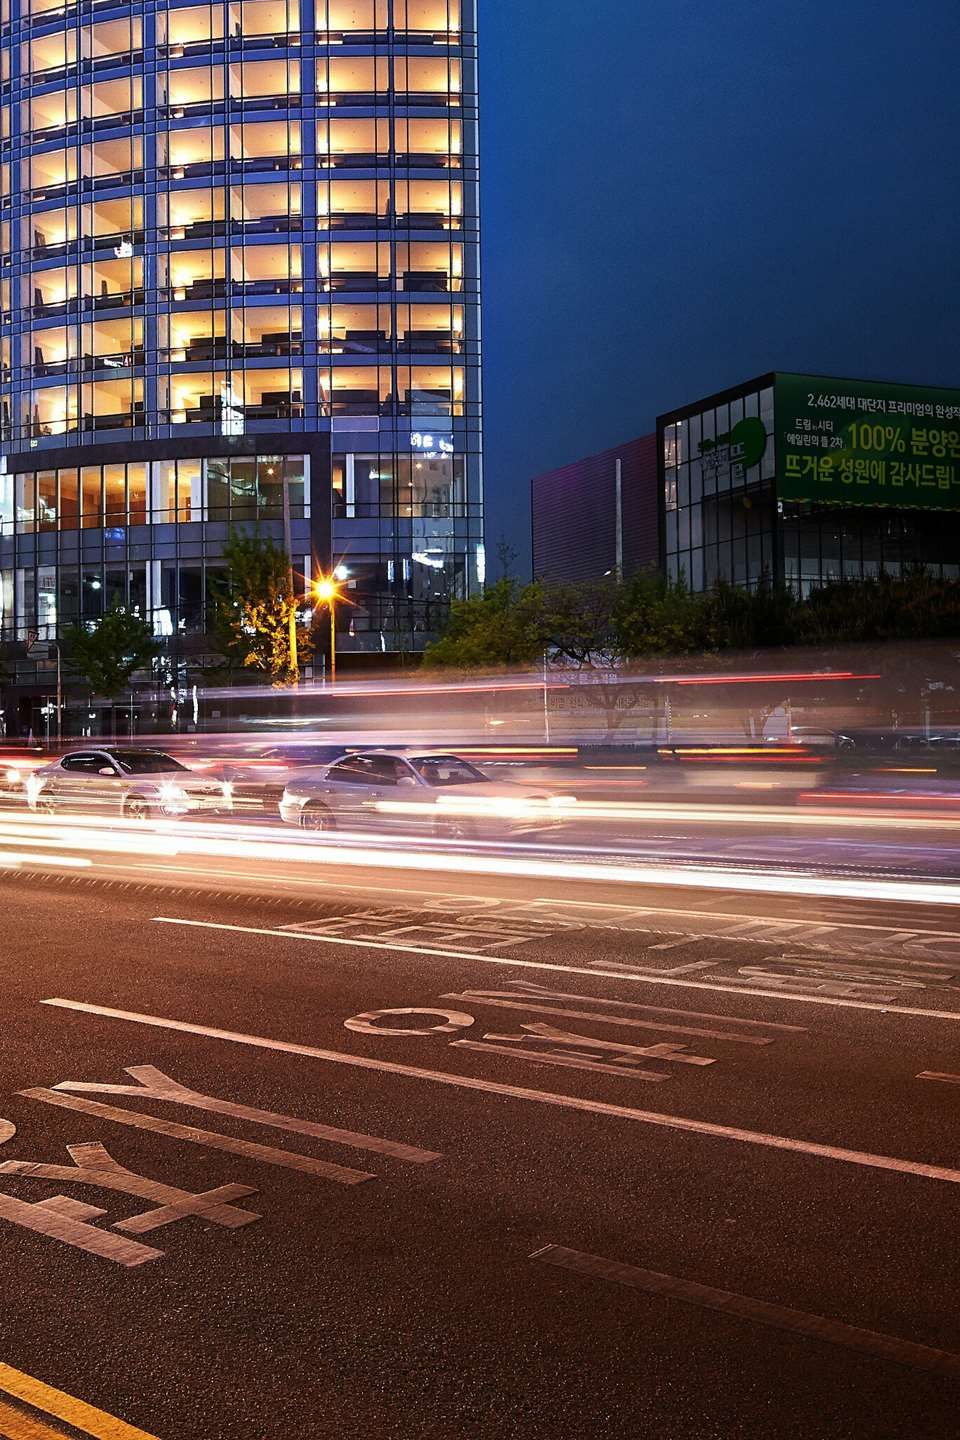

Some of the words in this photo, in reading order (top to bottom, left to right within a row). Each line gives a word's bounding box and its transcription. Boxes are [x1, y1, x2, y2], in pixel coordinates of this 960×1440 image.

[857, 397, 886, 414] 대단지
[888, 400, 934, 417] 프리미엄의
[848, 423, 906, 454] 100%
[784, 454, 835, 482] 뜨거운
[838, 458, 886, 486] 성원에
